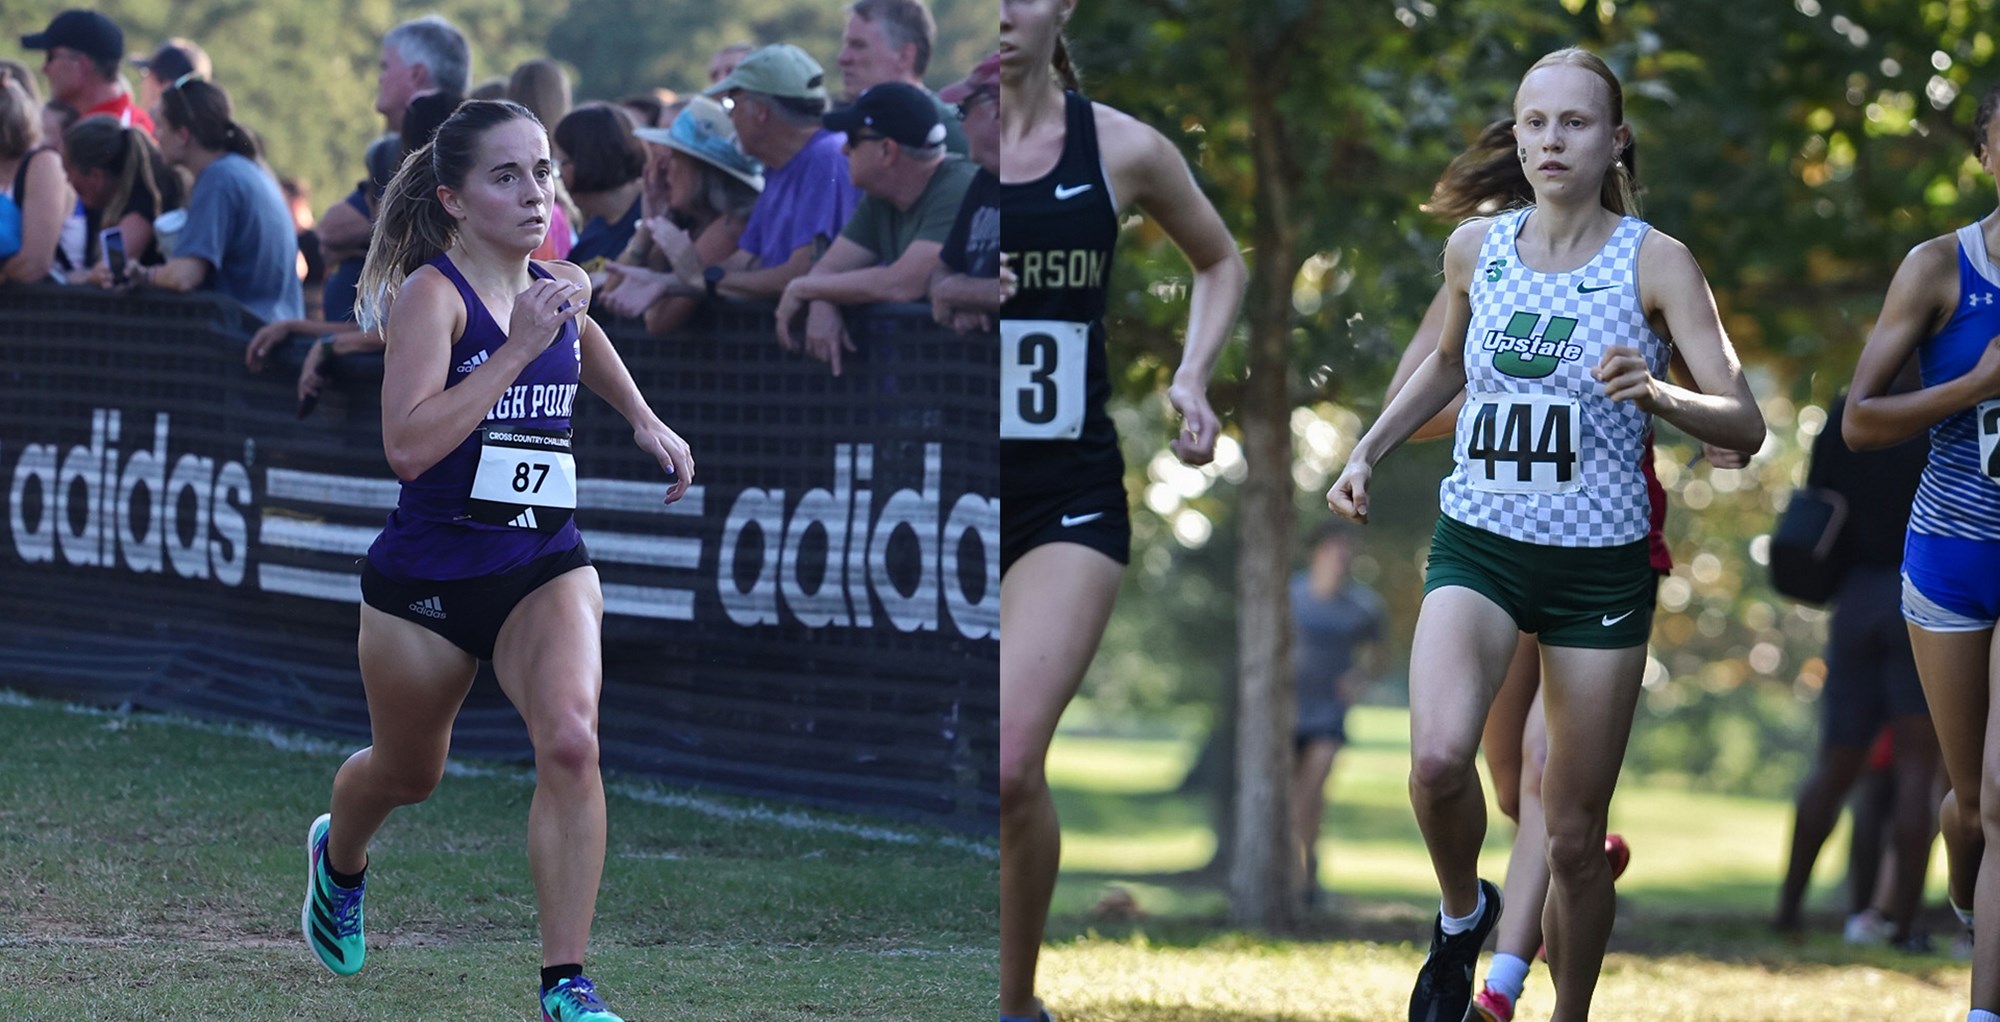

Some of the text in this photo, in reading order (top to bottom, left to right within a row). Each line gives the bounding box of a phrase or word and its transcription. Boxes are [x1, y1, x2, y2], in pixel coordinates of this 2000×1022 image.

[1482, 329, 1583, 362] Upstate
[1017, 331, 1058, 425] 3
[530, 383, 578, 418] POIN
[489, 431, 512, 442] CROSS
[513, 434, 543, 445] COUNTRY
[1468, 403, 1576, 482] 444
[512, 461, 551, 494] 87
[9, 408, 252, 586] adidas
[717, 442, 1000, 640] adida
[408, 603, 447, 620] adidas
